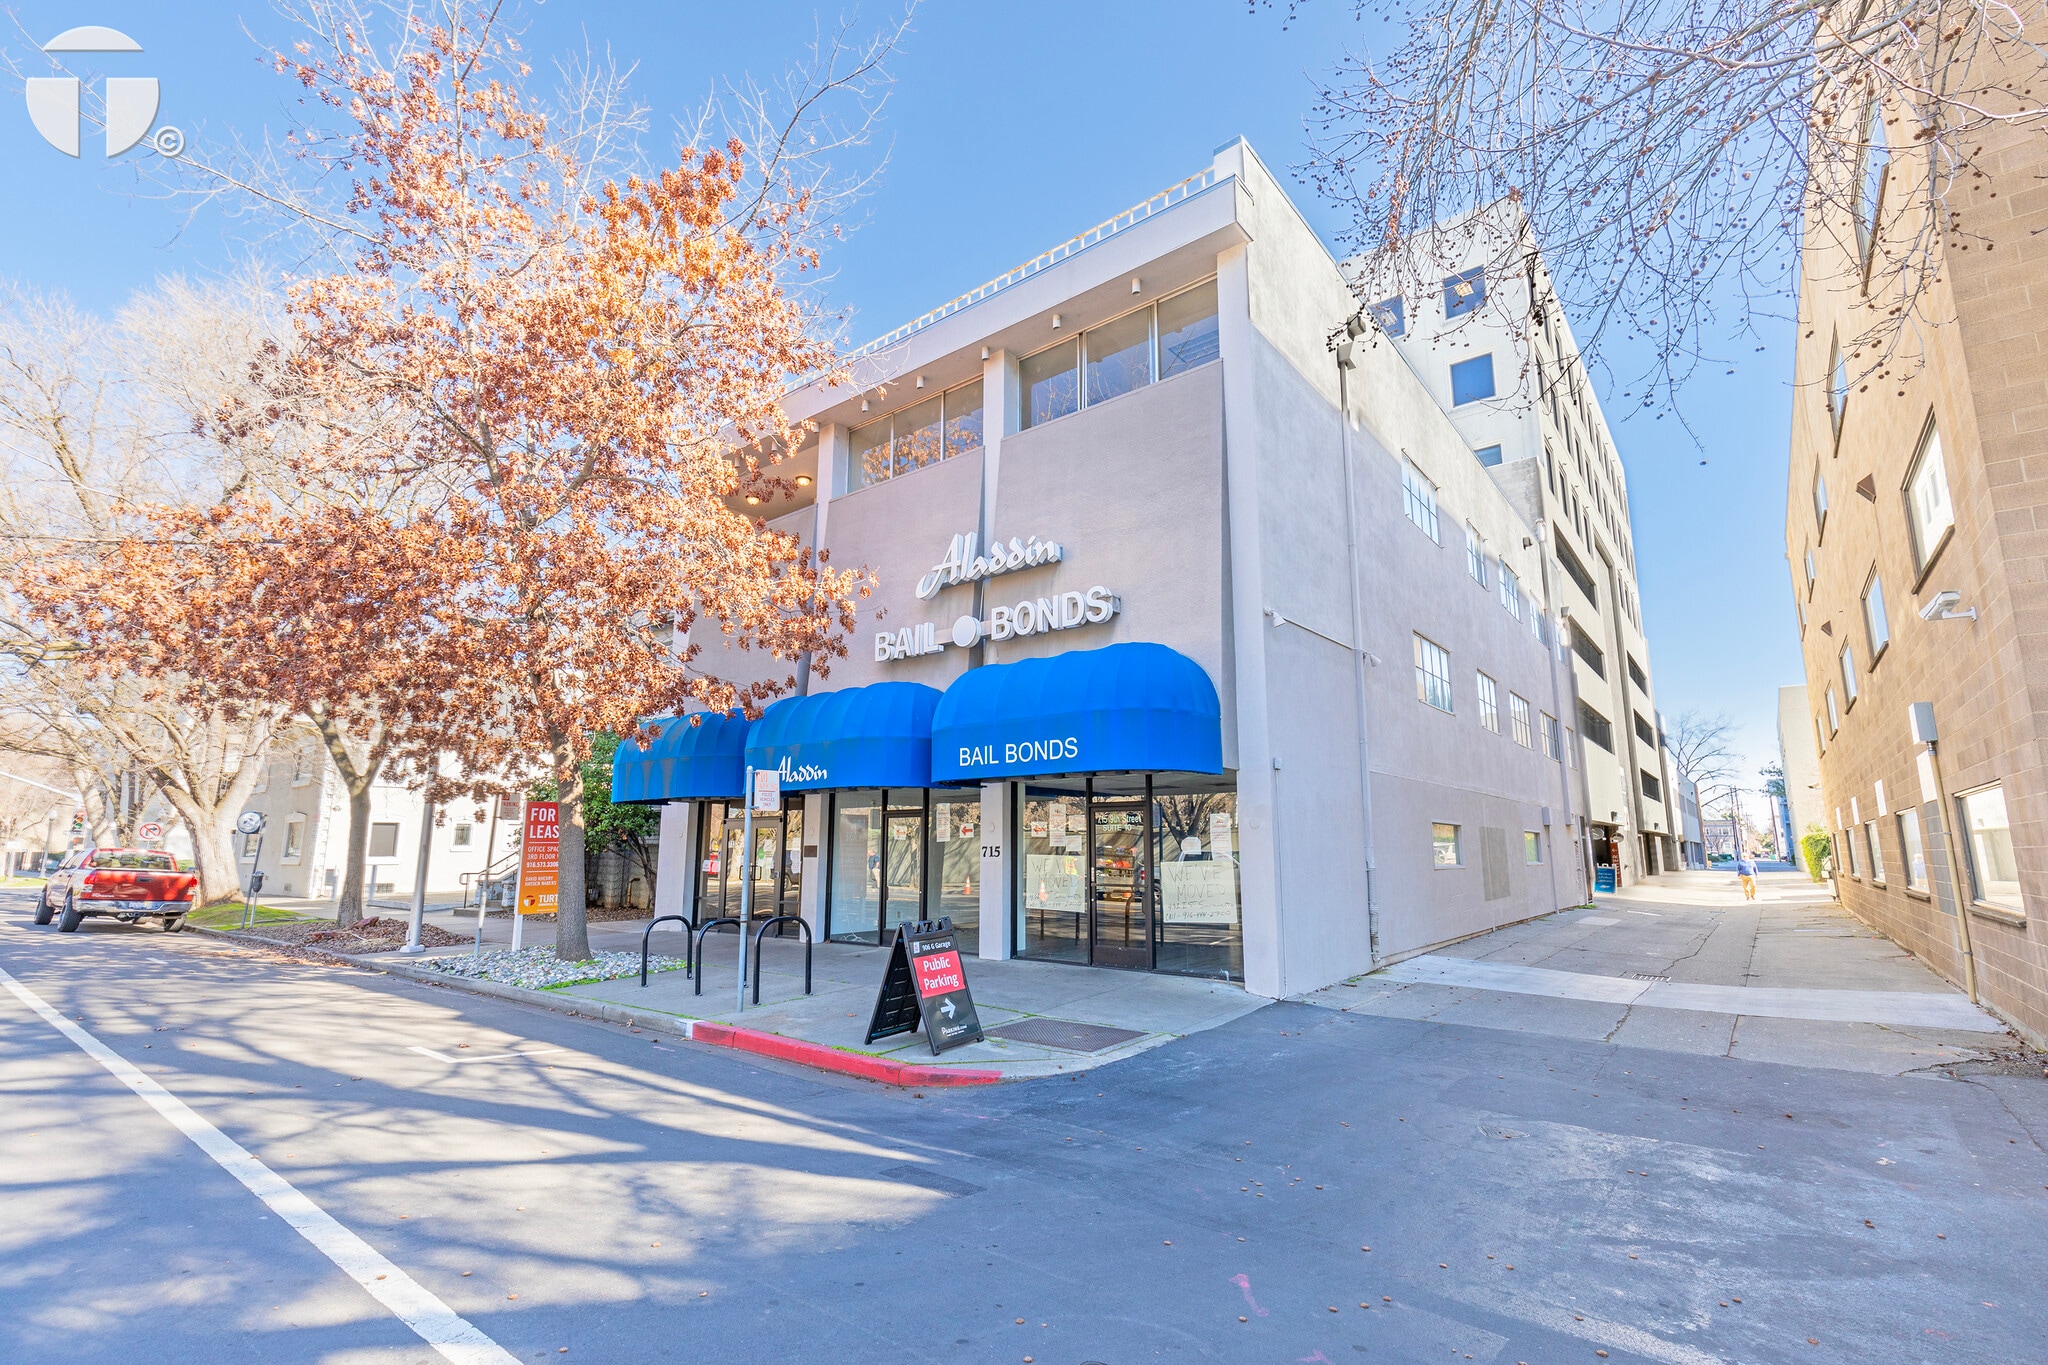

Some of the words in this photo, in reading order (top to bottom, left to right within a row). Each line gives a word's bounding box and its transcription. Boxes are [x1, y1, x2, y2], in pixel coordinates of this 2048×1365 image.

[916, 531, 1062, 600] Aladdin
[875, 622, 944, 662] BAIL
[991, 585, 1115, 642] BONDS
[959, 745, 999, 767] BAIL
[1005, 737, 1079, 764] BONDS
[778, 755, 828, 783] Aladdin
[531, 807, 556, 822] FOR
[529, 825, 559, 839] LEAS
[1102, 824, 1121, 832] SUITE
[527, 845, 546, 853] OFFICE
[981, 846, 1001, 858] 715
[527, 853, 538, 861] 3RD
[538, 894, 559, 903] TURT
[1177, 884, 1226, 901] MOVED
[935, 941, 951, 949] Garage
[923, 957, 951, 972] Public
[924, 974, 959, 990] Parking
